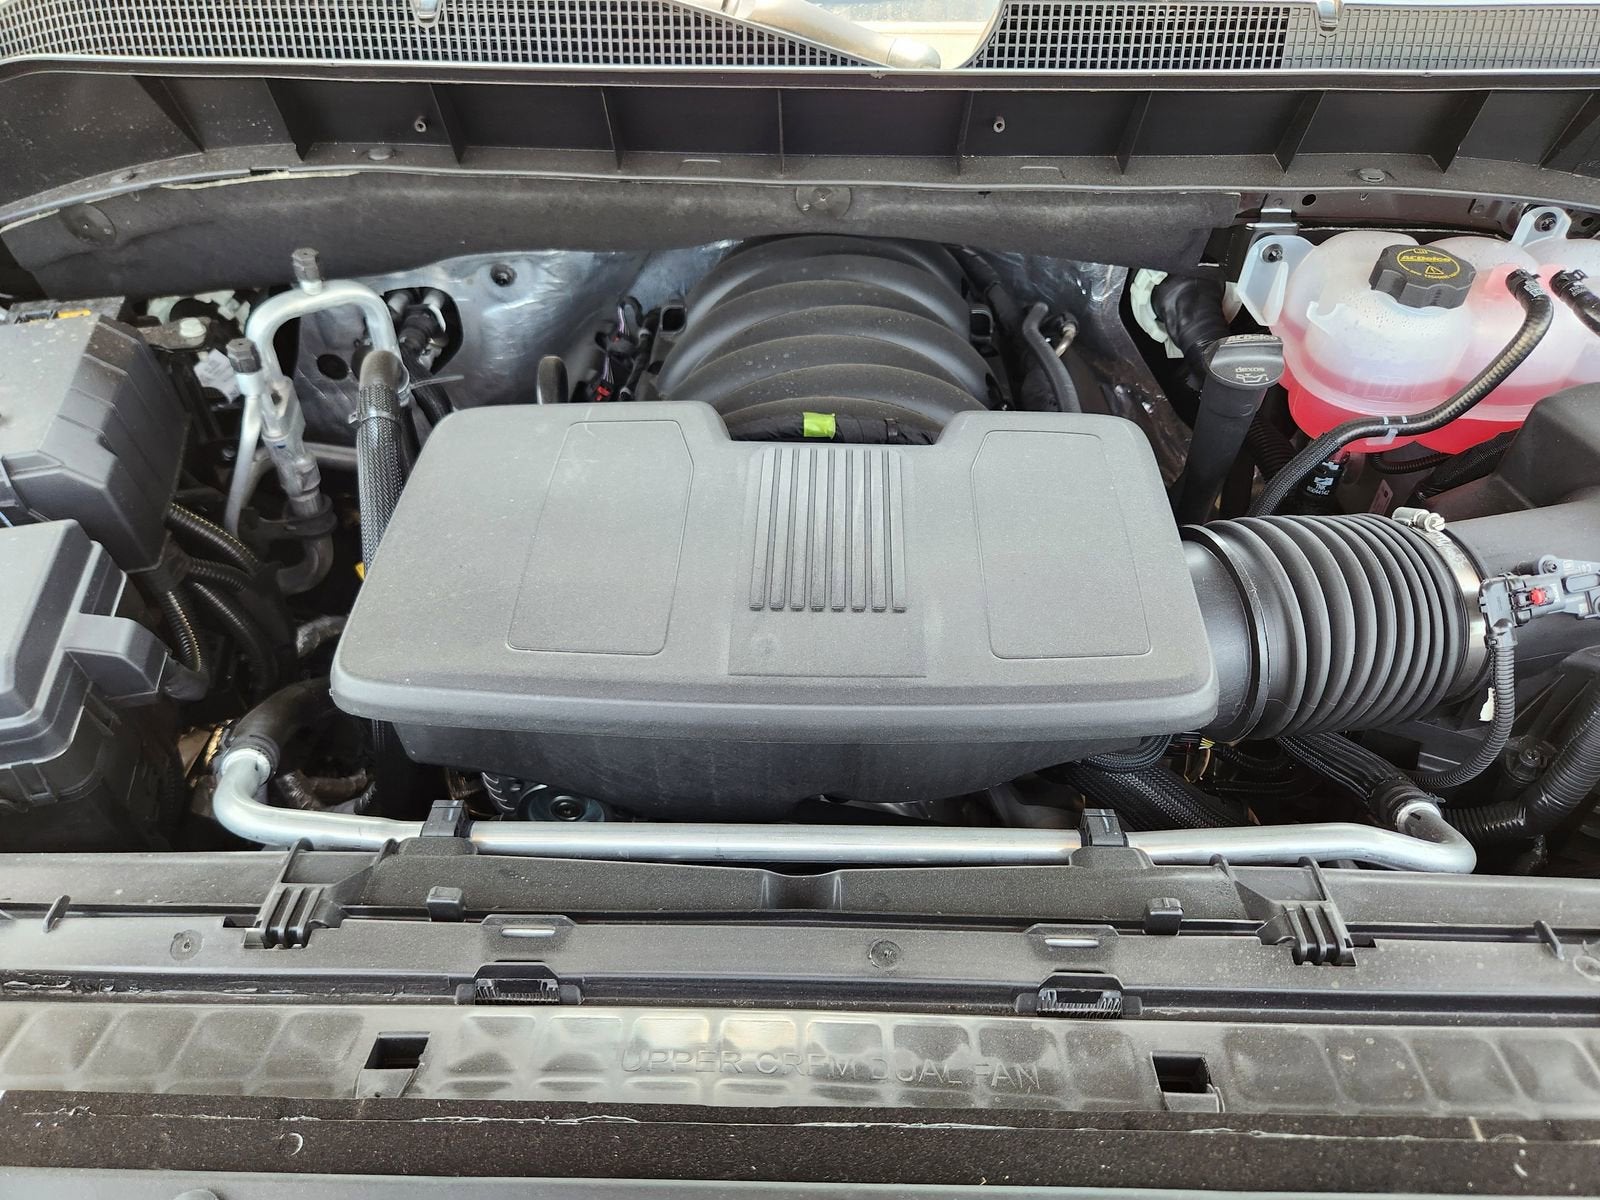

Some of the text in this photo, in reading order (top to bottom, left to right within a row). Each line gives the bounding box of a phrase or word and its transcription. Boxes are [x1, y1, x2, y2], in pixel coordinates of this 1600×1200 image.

[1400, 255, 1452, 263] ACDelco
[1226, 333, 1279, 343] ACDelco
[621, 1049, 743, 1074] UPPER
[869, 1058, 963, 1084] DUAL
[974, 1061, 1041, 1090] FAN
